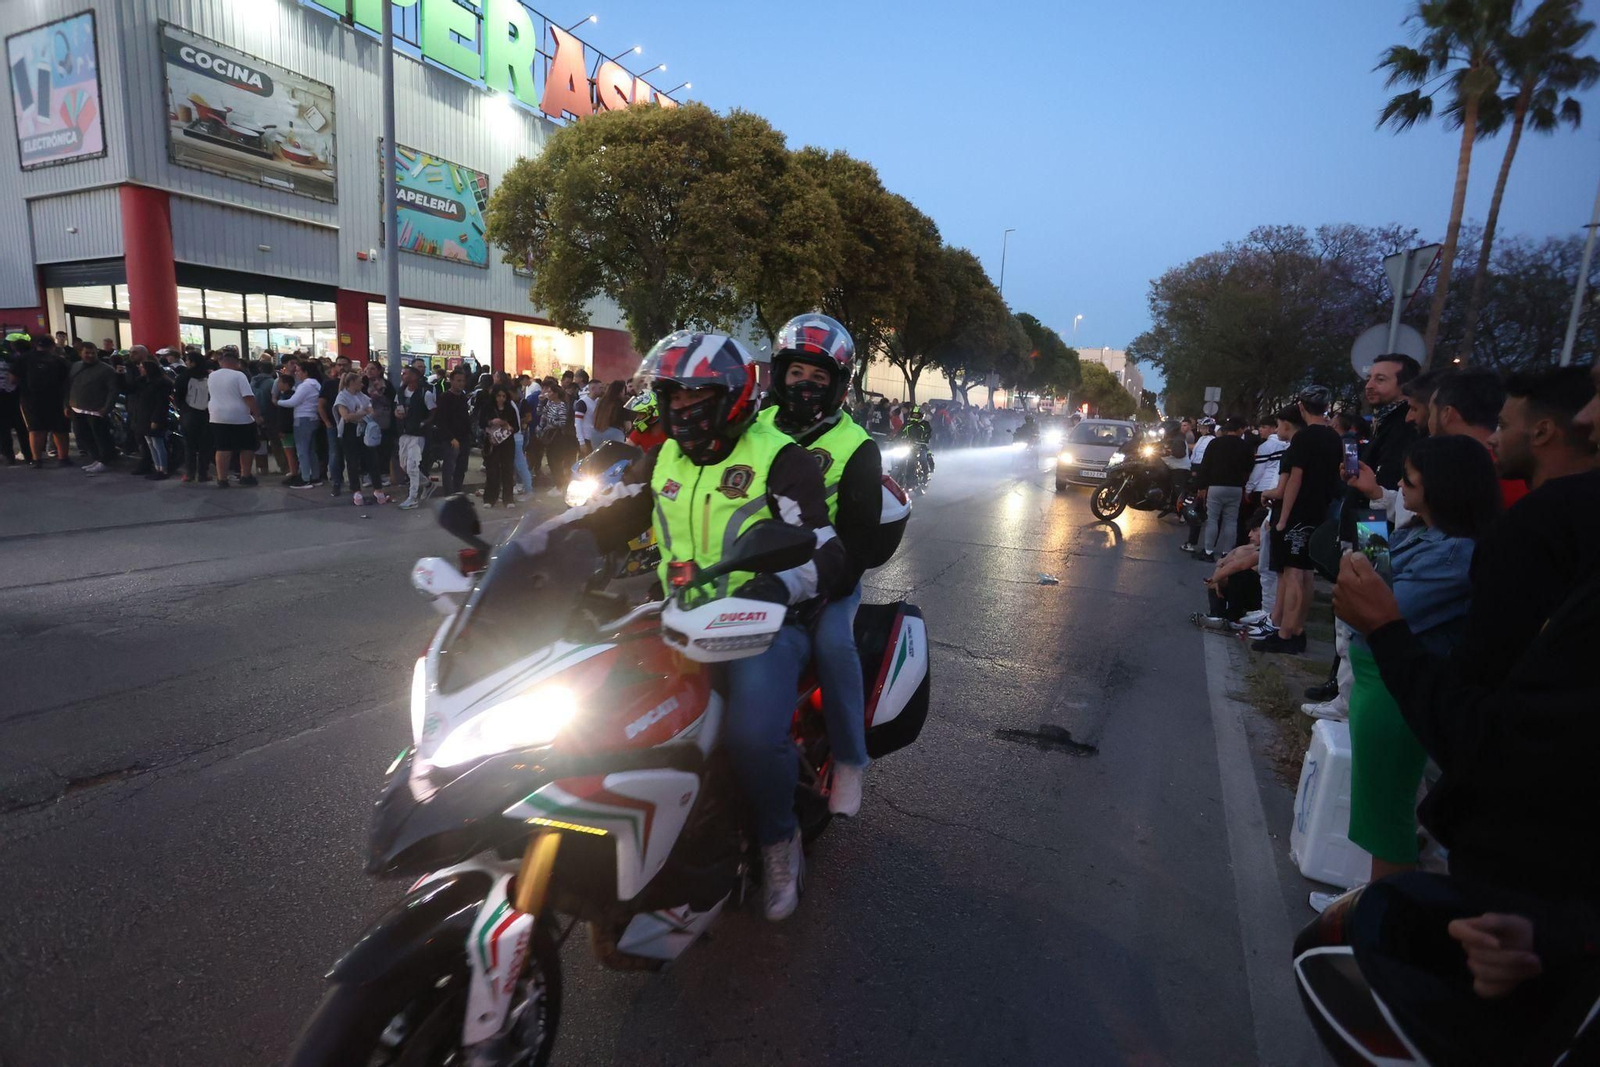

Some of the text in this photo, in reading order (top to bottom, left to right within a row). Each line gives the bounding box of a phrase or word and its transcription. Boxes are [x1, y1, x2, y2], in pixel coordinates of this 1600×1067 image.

[179, 46, 263, 89] COCINA
[23, 130, 78, 153] ELECTRÓNICA
[396, 187, 458, 215] APELERÍA
[720, 611, 767, 622] DUCATI
